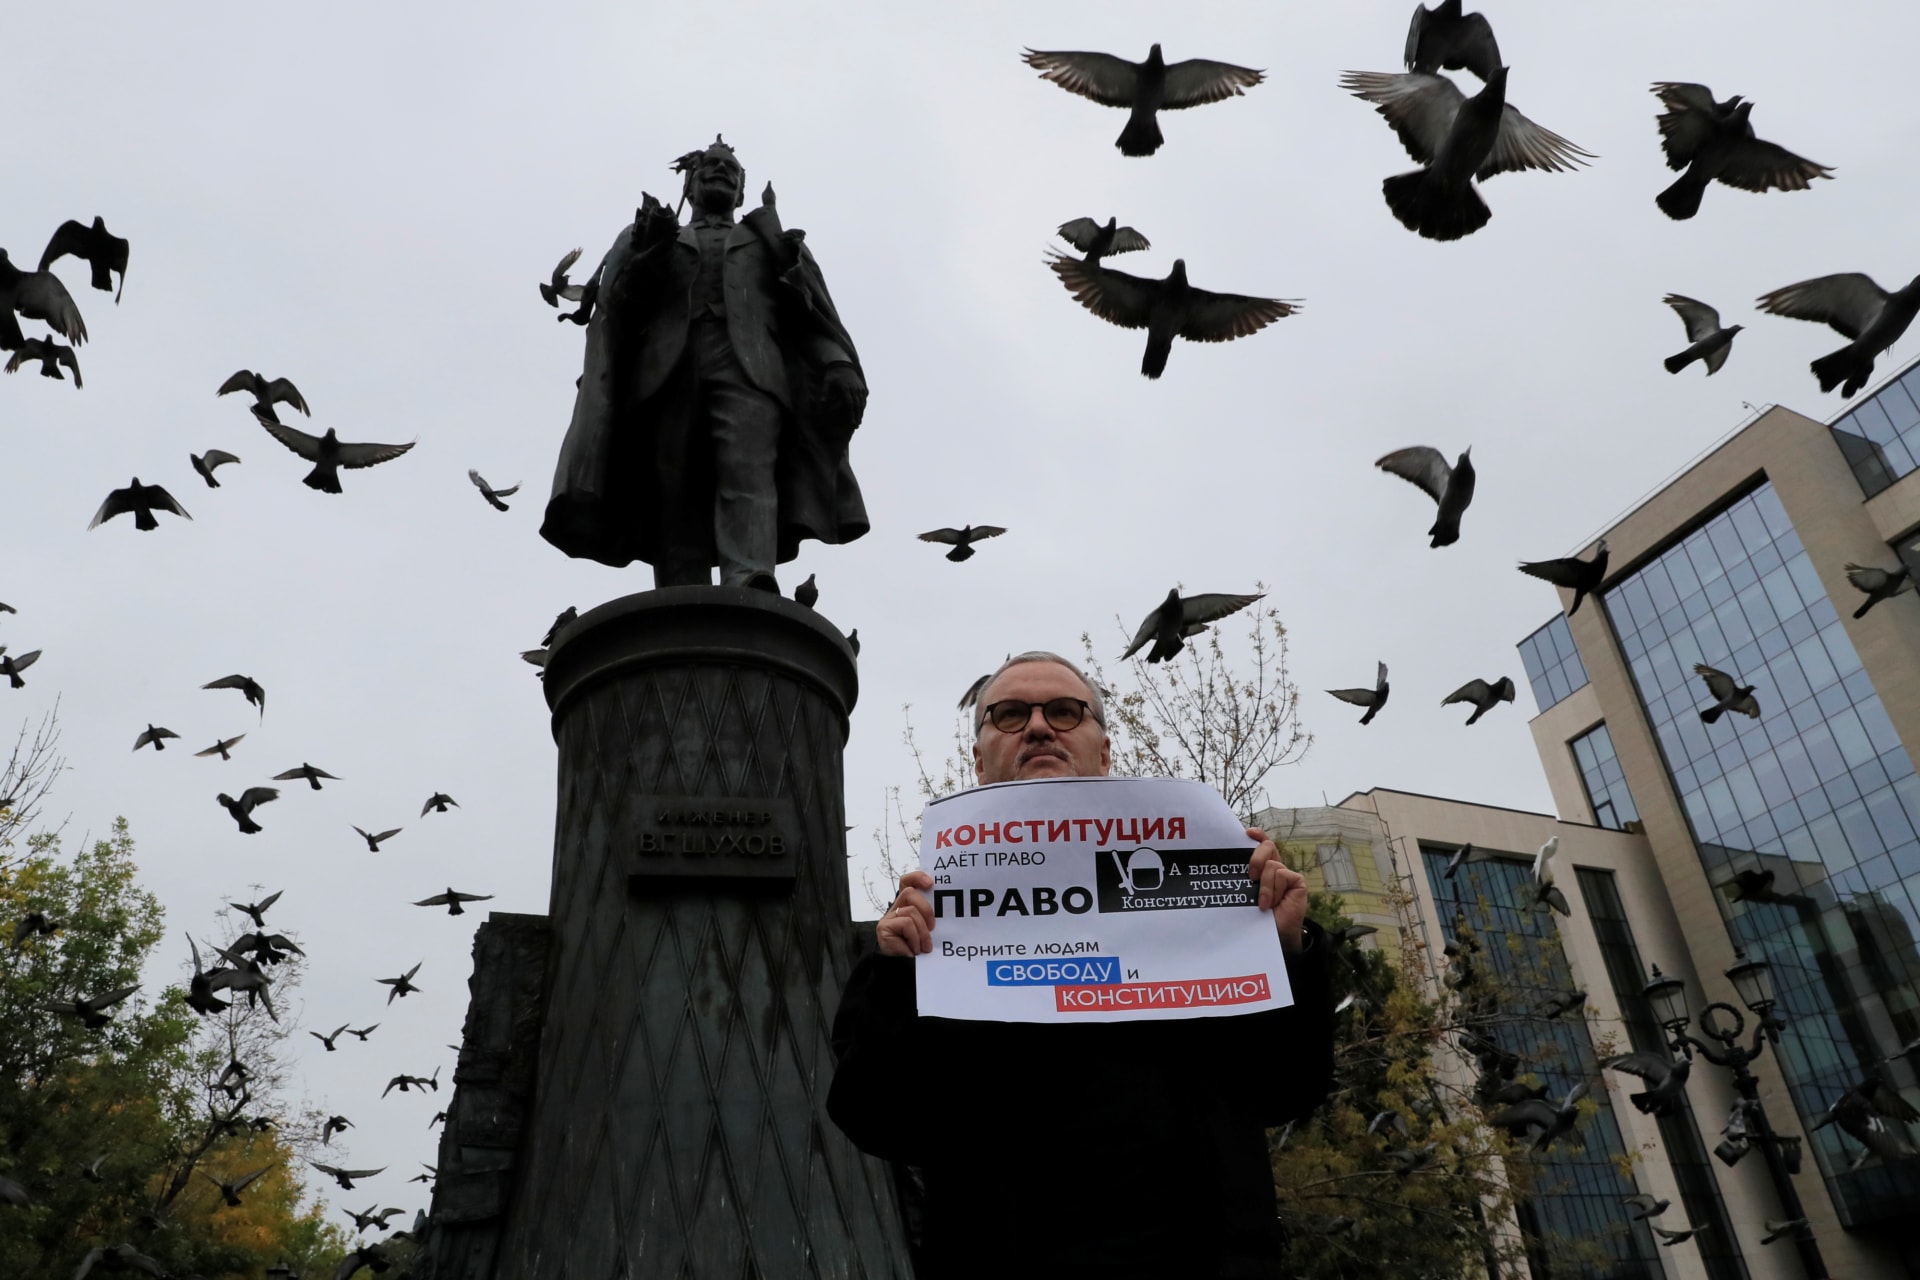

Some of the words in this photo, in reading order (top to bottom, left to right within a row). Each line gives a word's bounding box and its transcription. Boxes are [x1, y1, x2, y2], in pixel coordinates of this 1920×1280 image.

[657, 808, 773, 825] ИНЖЕНЕР
[935, 817, 1186, 849] КОНСТИТУЦИЯ
[682, 832, 786, 855] ШУХОВ
[933, 851, 979, 870] ДАЁТ
[984, 851, 1046, 867] ПРАВО
[1168, 862, 1182, 876] А
[934, 874, 952, 885] на
[1190, 878, 1254, 891] топчут
[934, 886, 1093, 918] ПРАВО
[1121, 893, 1255, 909] Конституцию.
[942, 941, 1027, 961] Верните
[1033, 941, 1100, 956] людям
[995, 961, 1113, 982] СВОБОДУ
[1127, 968, 1140, 980] и
[1062, 979, 1267, 1006] КОНСТИТУЦИЮ!
